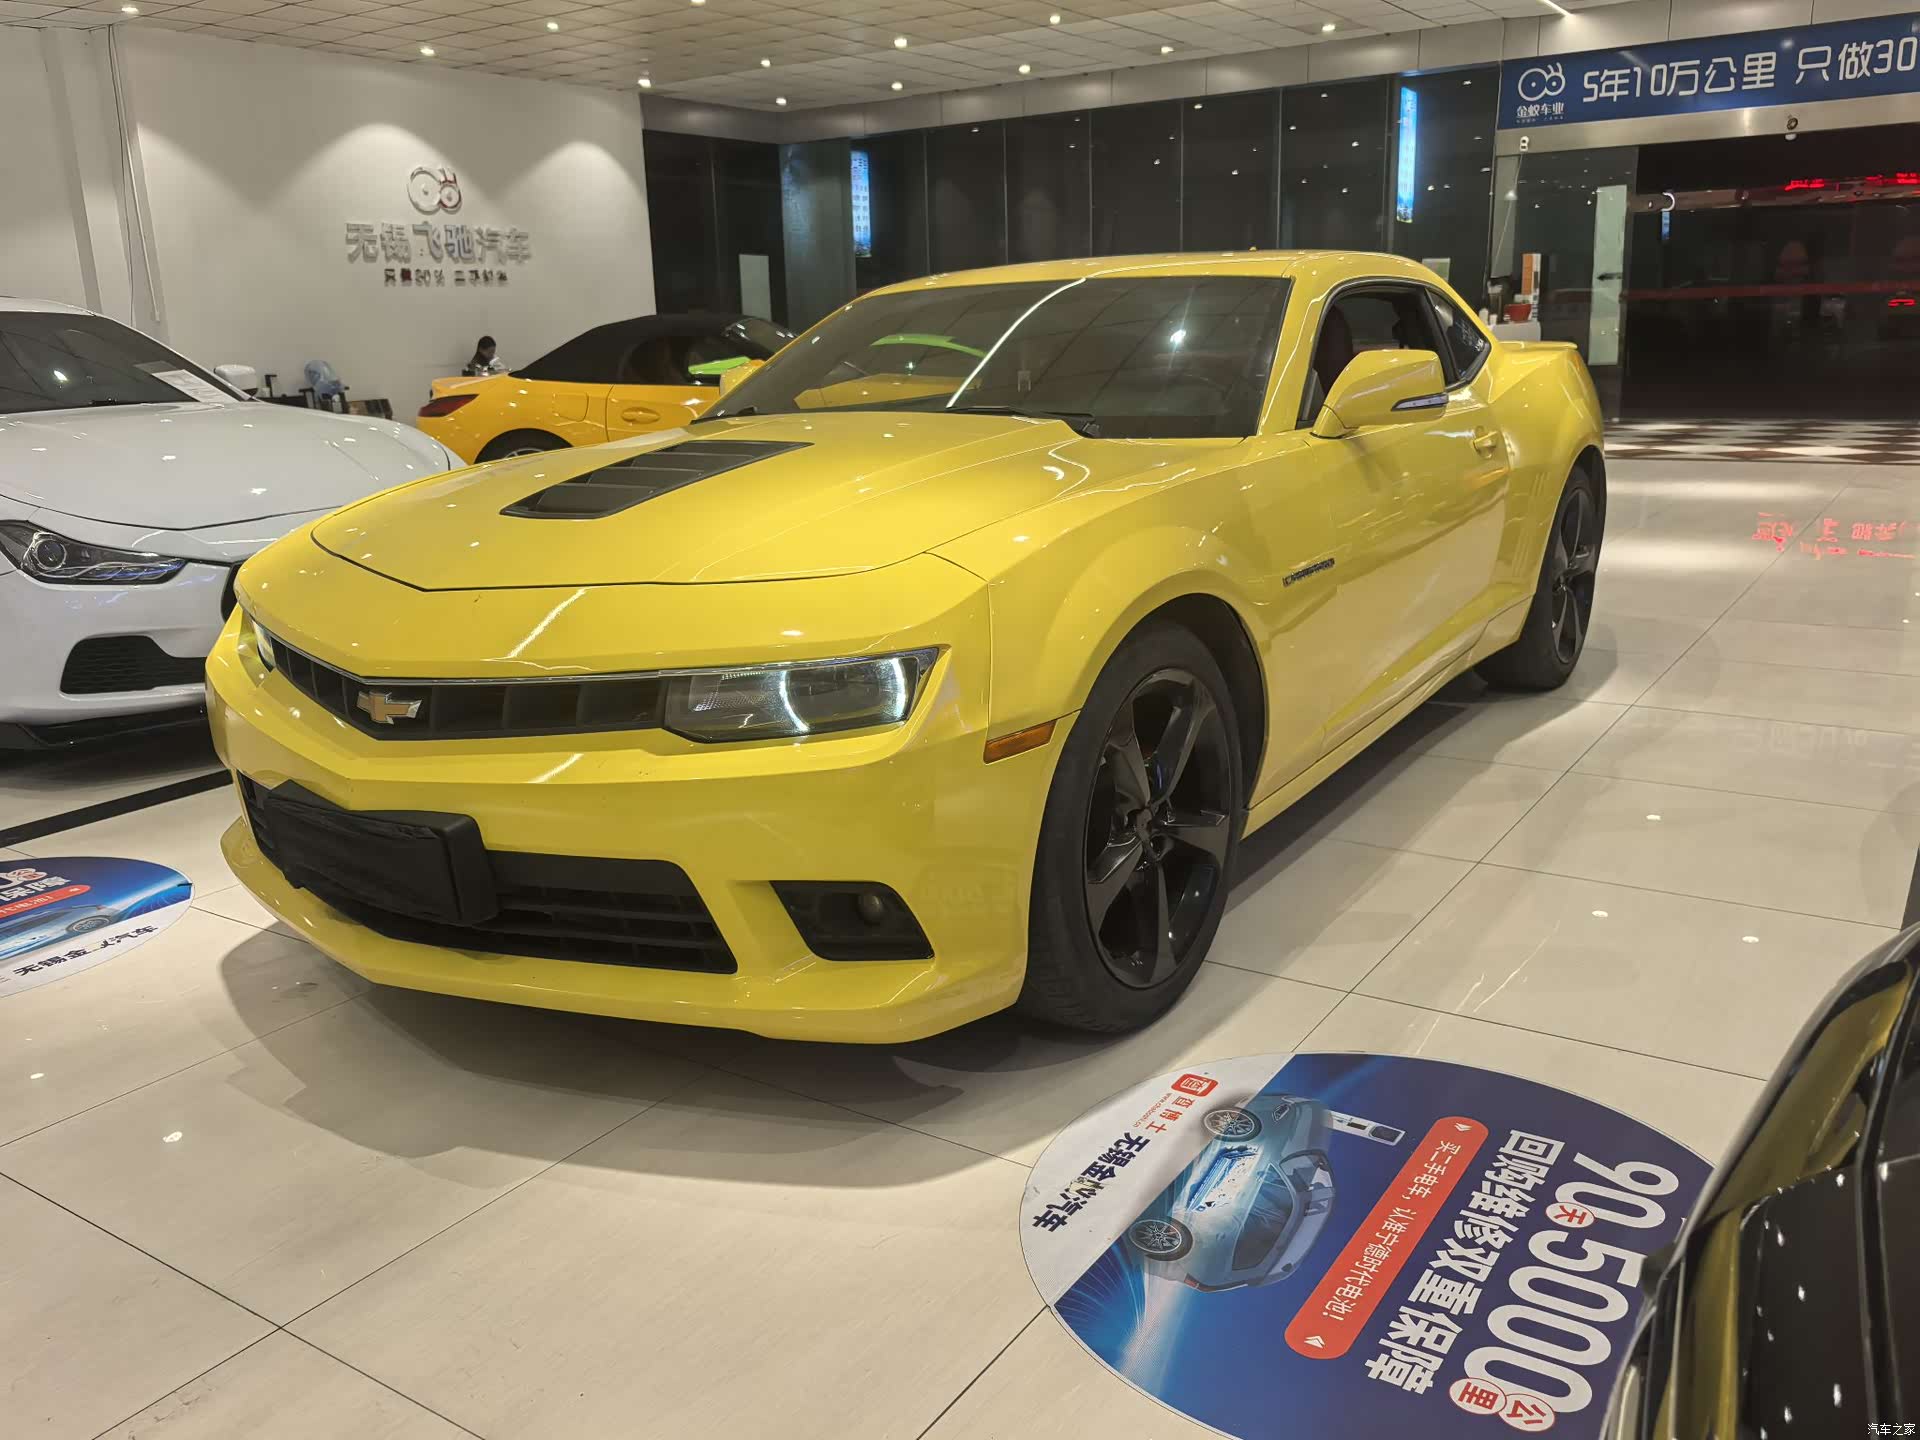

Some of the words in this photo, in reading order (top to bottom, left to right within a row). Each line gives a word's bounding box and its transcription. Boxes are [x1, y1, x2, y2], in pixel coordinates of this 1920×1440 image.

[1583, 51, 1777, 103] 5年10万公里
[1365, 1129, 1566, 1395] 回购维修双重保障
